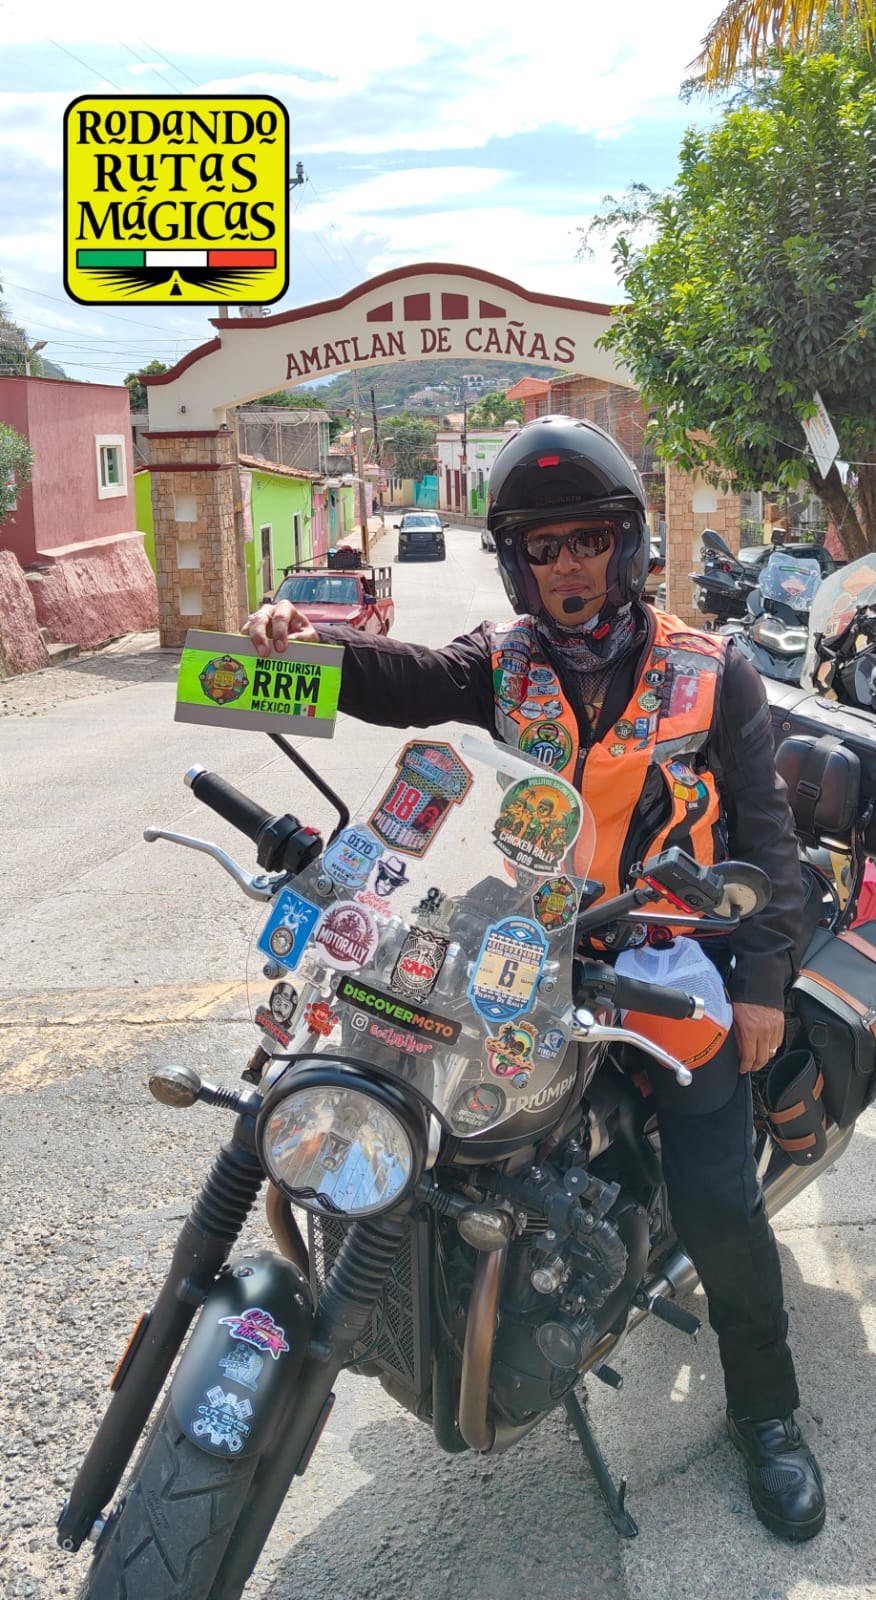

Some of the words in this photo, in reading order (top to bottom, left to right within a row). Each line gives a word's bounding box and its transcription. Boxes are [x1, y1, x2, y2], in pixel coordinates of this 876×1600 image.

[285, 331, 406, 380] AMATLAN
[420, 327, 451, 354] DE
[465, 320, 576, 363] CAÑAS
[255, 658, 321, 677] MOTOTURISTA
[252, 670, 321, 703] RRM
[251, 699, 291, 714] MÉXICO
[536, 746, 554, 766] 10
[384, 780, 422, 821] 18
[348, 834, 374, 855] 0170
[499, 831, 534, 856] CHICKEN
[531, 845, 555, 863] RALLY
[515, 852, 533, 867] 009
[319, 926, 368, 964] MOTORALLY
[498, 960, 519, 988] 6
[505, 1072, 577, 1113] TRIUMPH
